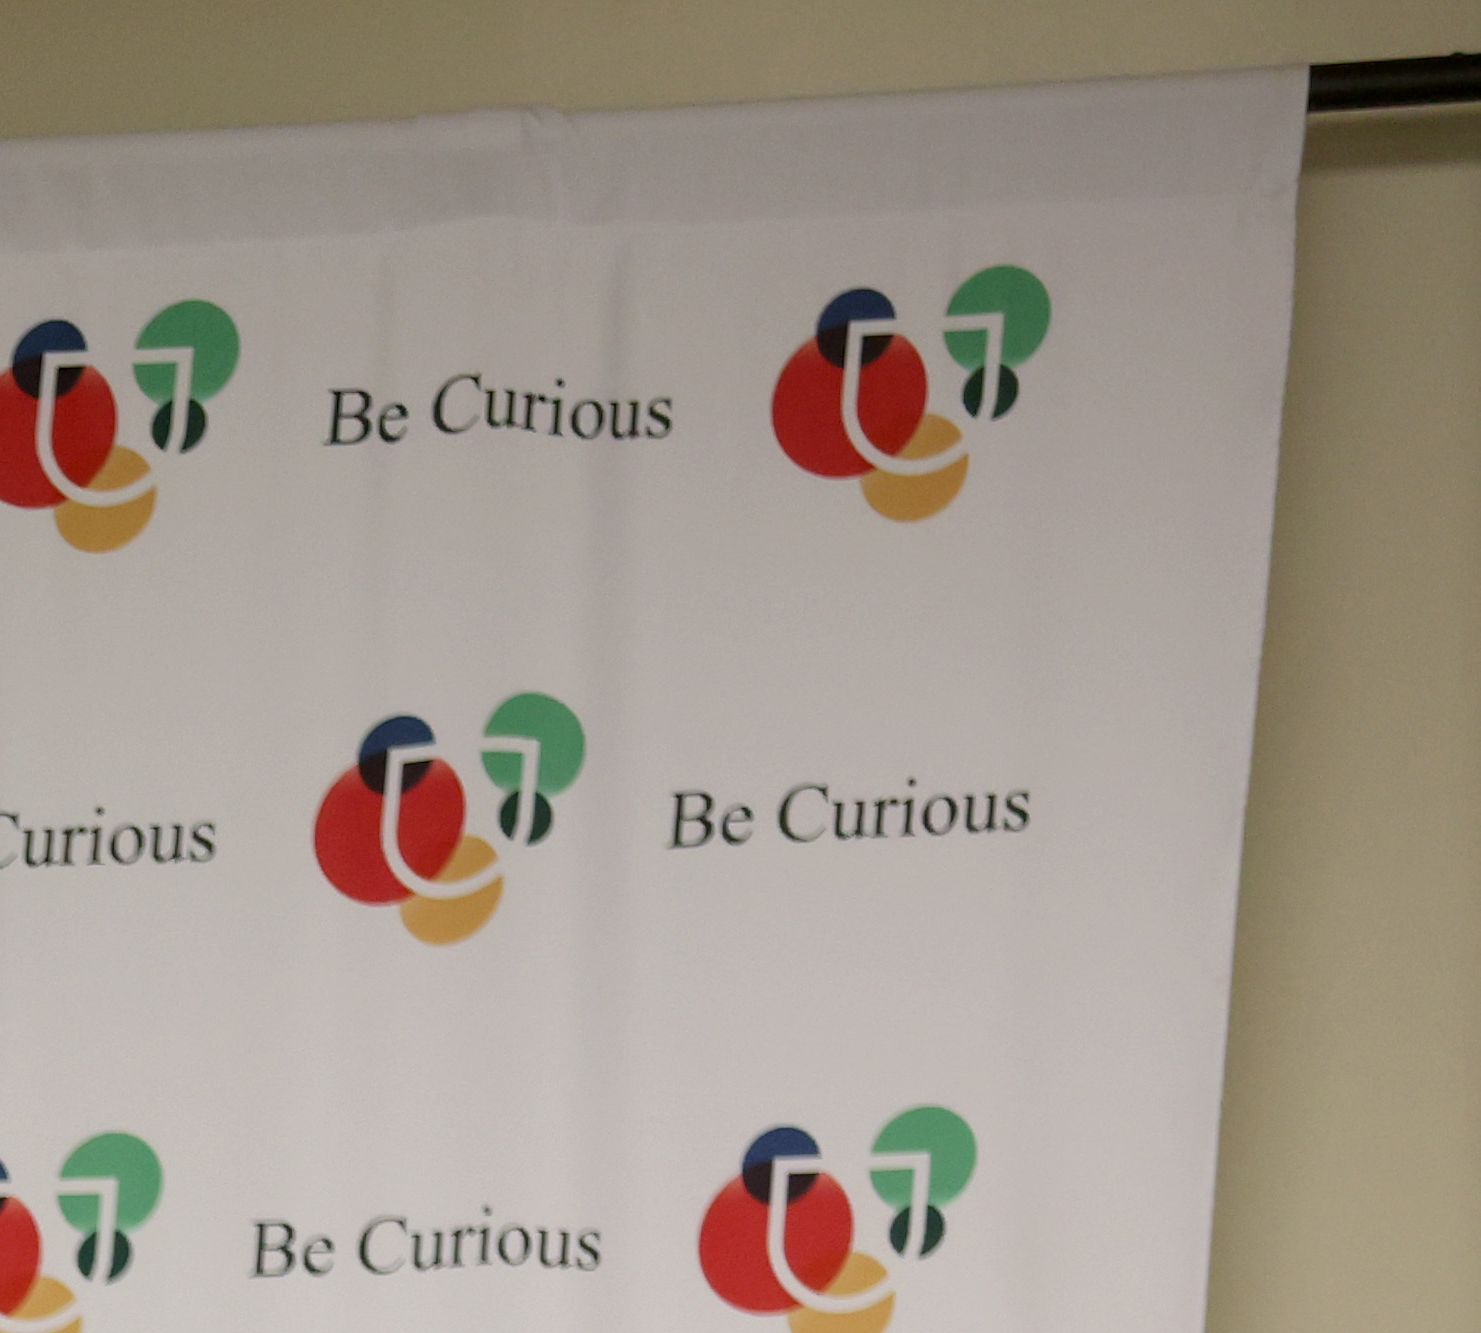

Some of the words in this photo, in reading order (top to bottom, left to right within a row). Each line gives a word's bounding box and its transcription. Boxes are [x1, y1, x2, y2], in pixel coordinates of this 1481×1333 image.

[322, 387, 411, 448] Be
[430, 371, 674, 442] Curious
[667, 789, 756, 851] Be
[775, 775, 1032, 845] Curious
[251, 1219, 337, 1279] Be
[356, 1204, 603, 1277] Curious
